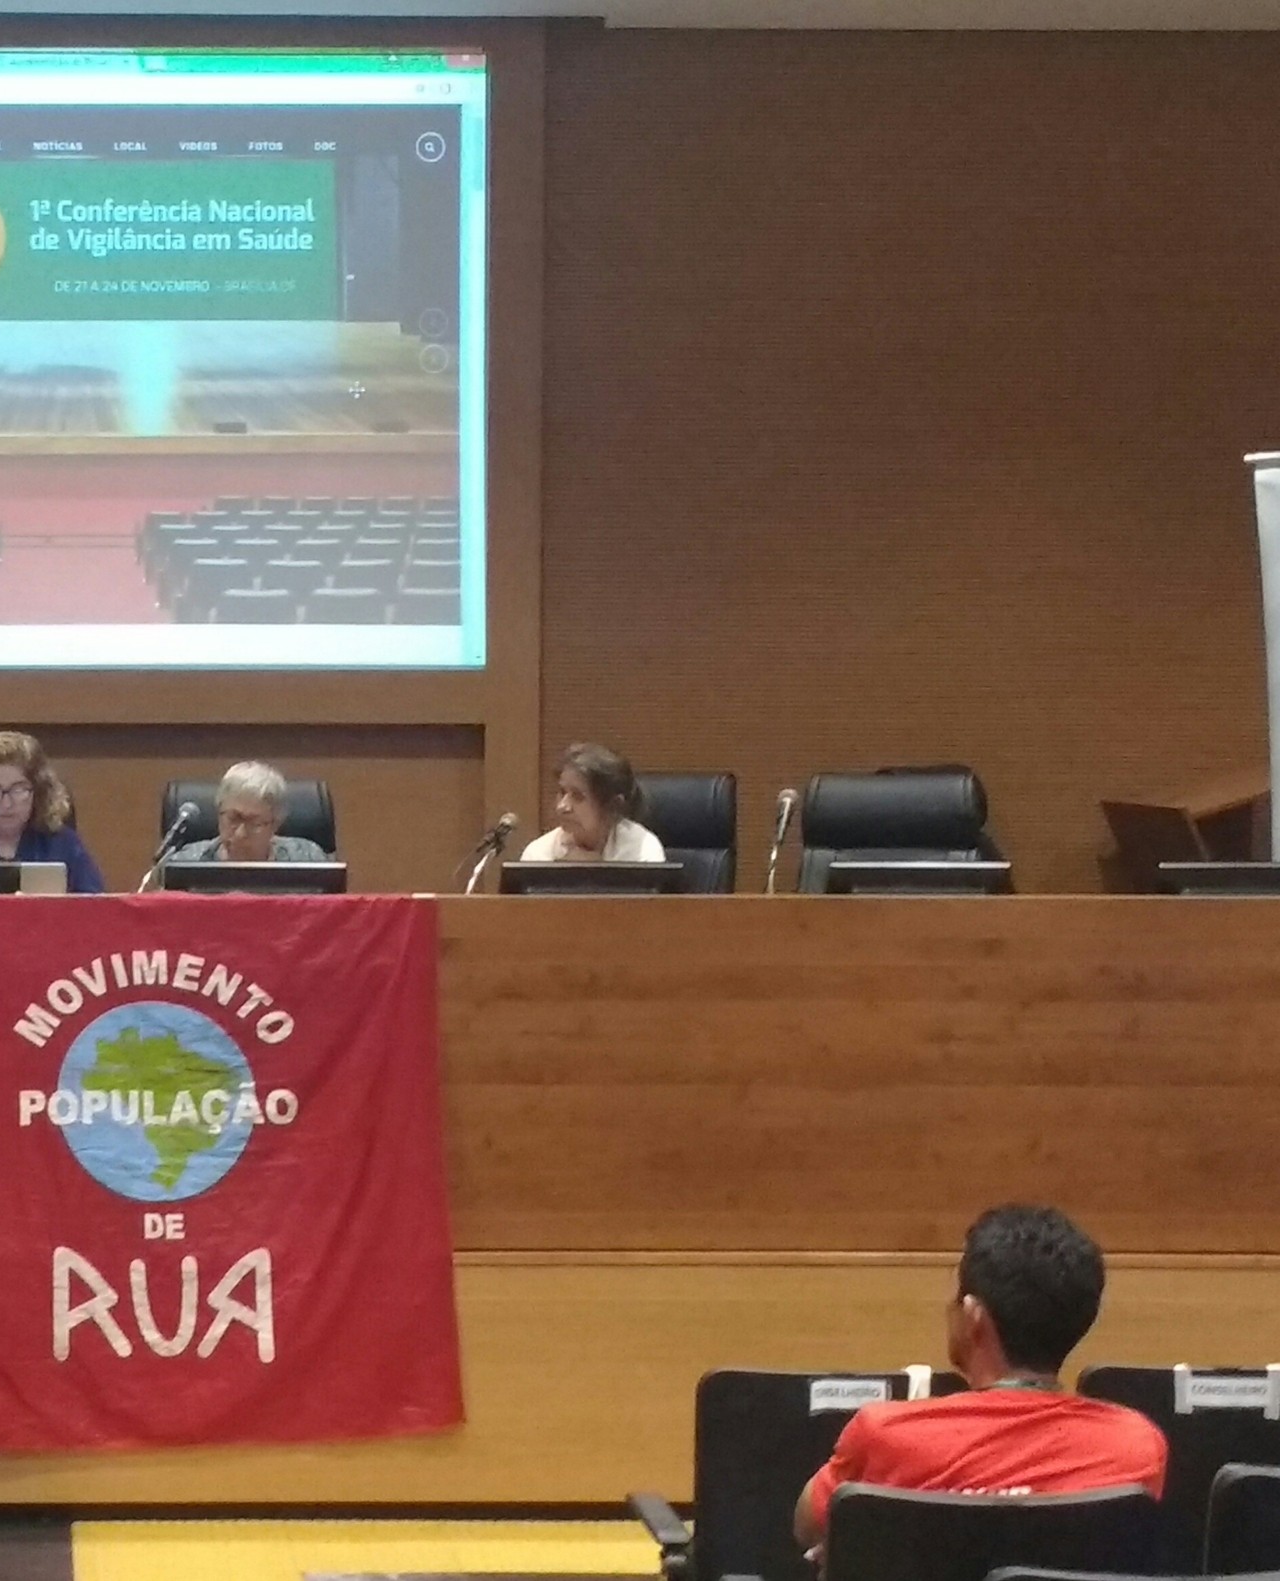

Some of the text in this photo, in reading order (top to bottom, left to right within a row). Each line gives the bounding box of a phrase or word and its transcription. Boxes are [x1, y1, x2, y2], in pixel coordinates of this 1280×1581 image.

[114, 141, 147, 151] LOCAL
[248, 141, 283, 151] FOTOS
[314, 141, 336, 151] DOC
[29, 197, 315, 222] 1ª Conferência Nacional
[29, 226, 313, 257] de Vigilância em Saúde
[54, 280, 71, 292] DE
[73, 280, 87, 292] 21
[90, 280, 99, 292] A
[101, 280, 119, 292] 24
[121, 280, 138, 292] DE
[140, 280, 210, 292] NOVEMBRO
[13, 949, 295, 1048] MOVIMENTO
[19, 1082, 299, 1134] POPULAÇÃO
[143, 1212, 186, 1241] DE
[52, 1246, 277, 1363] RUA
